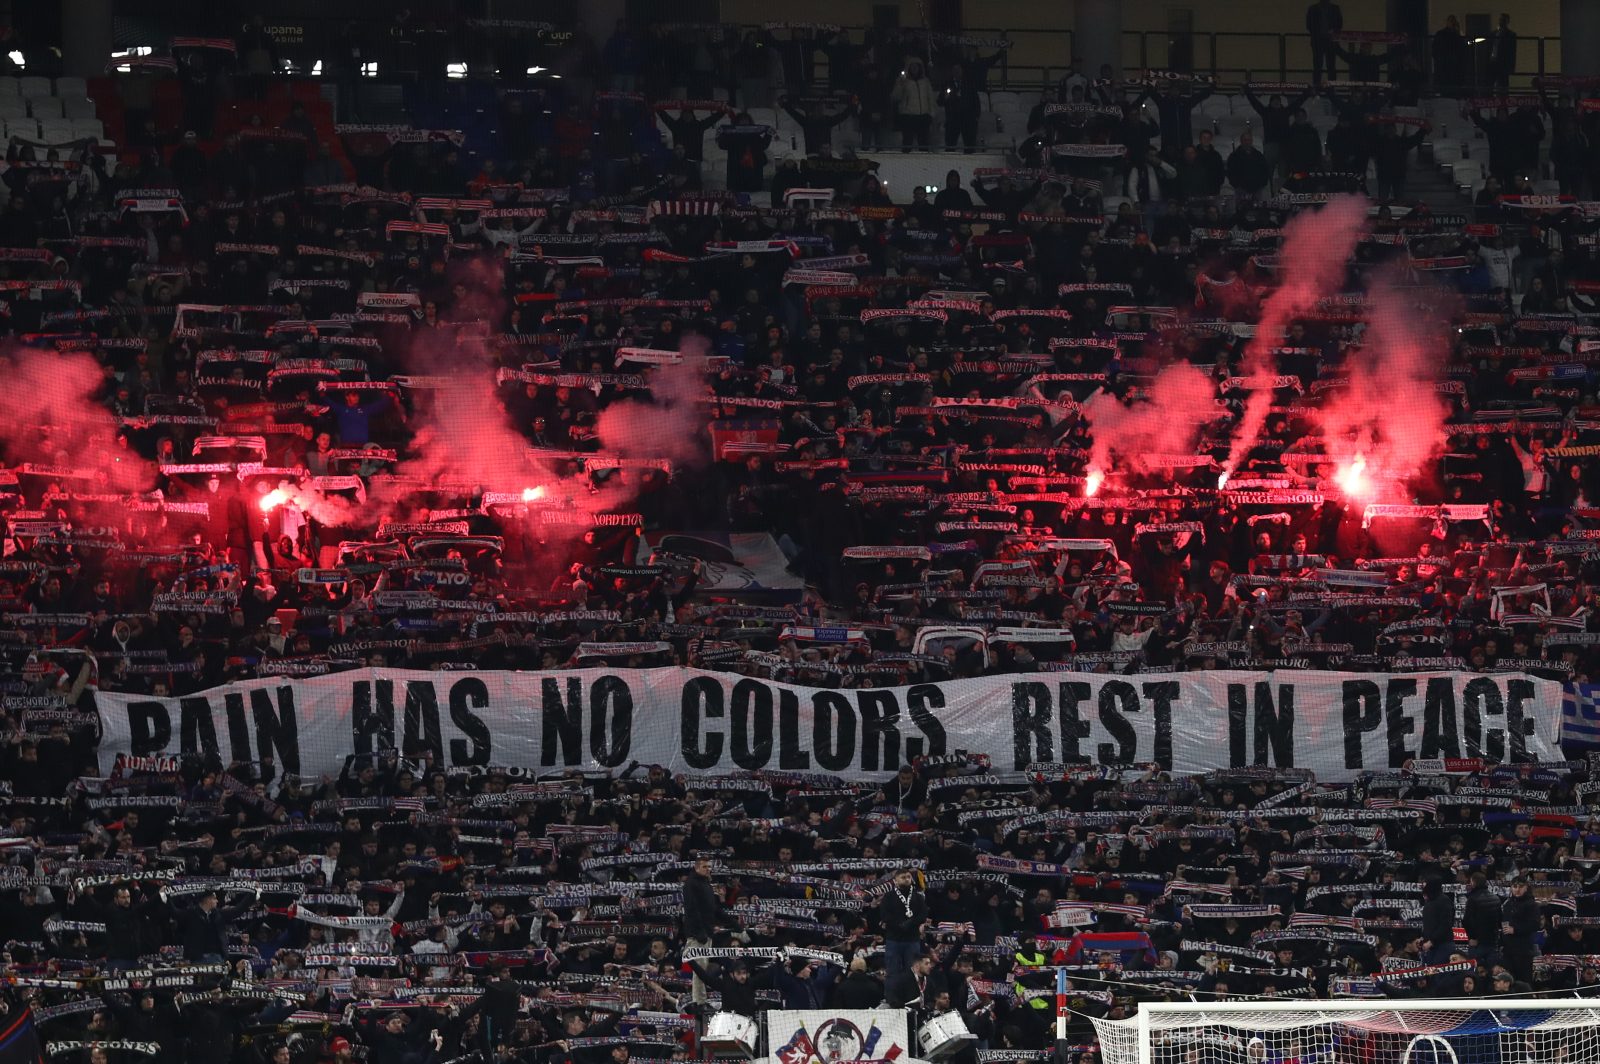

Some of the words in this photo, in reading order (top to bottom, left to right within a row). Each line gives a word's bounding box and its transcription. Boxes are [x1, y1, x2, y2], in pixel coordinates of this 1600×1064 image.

[1520, 195, 1560, 204] GONE
[336, 381, 368, 389] ALLEZ
[1229, 494, 1275, 504] VIRAGE
[1287, 494, 1323, 503] NORD
[128, 686, 298, 781] PAIN
[353, 680, 488, 770] HAS
[542, 677, 632, 770] NO
[1011, 680, 1180, 770] REST
[1228, 684, 1294, 770] IN
[1343, 677, 1535, 772] PEACE
[1288, 806, 1316, 818] LYON
[791, 860, 831, 872] VIRAGE
[832, 859, 864, 872] NORD
[305, 956, 331, 966] BAD
[349, 955, 398, 966] GONES
[104, 979, 130, 990] BAD
[155, 975, 195, 988] GONES
[95, 1038, 158, 1056] GONES
